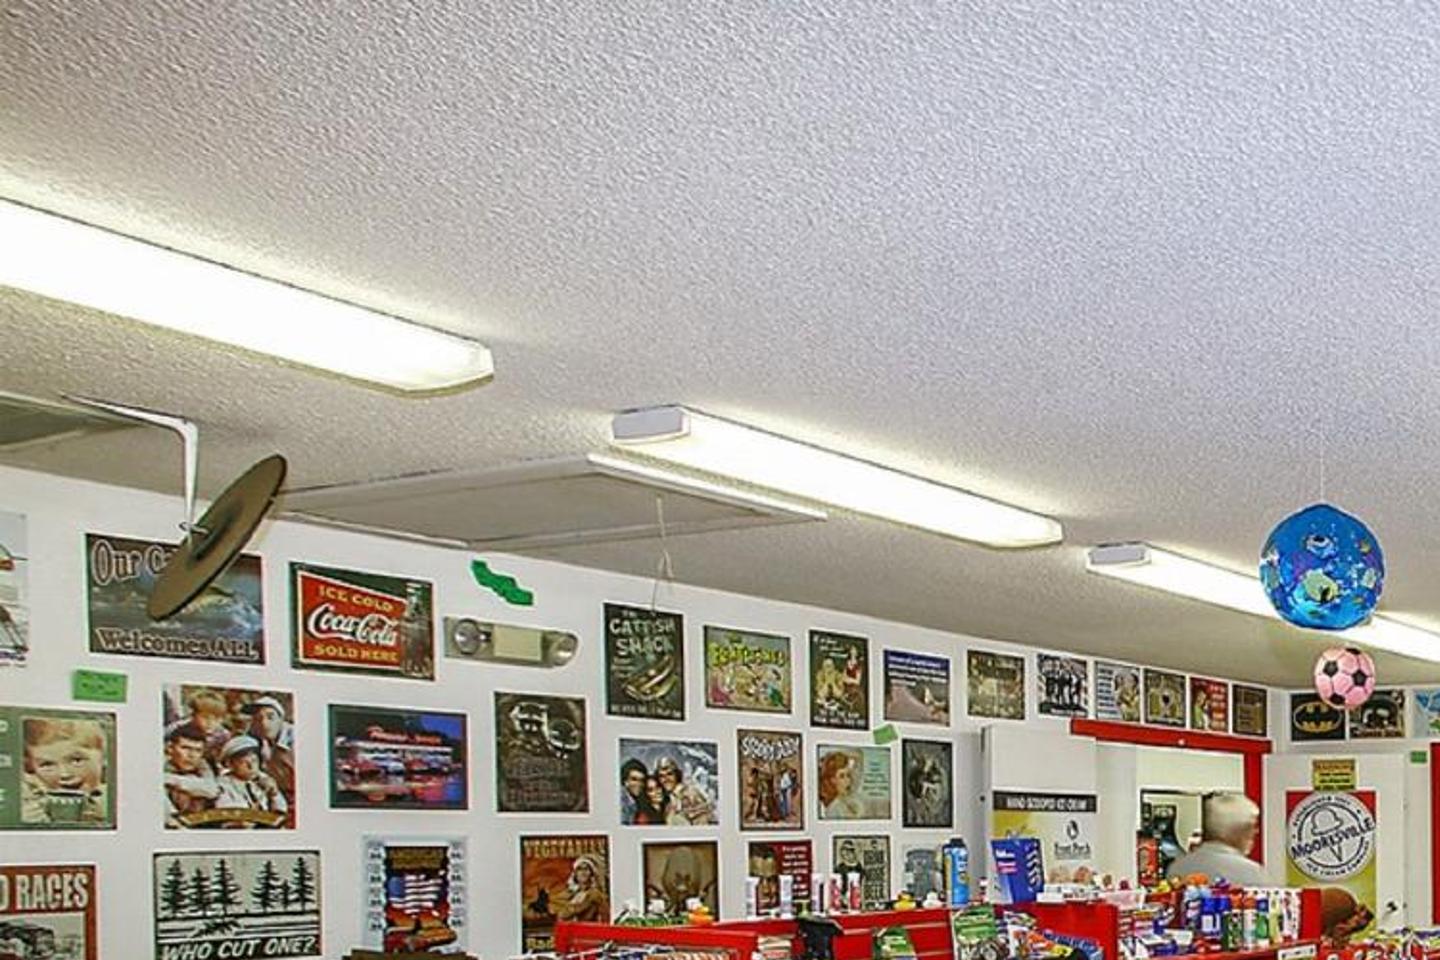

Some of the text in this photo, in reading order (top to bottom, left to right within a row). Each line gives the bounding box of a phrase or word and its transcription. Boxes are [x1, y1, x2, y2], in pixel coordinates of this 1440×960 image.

[93, 539, 142, 586] Our
[319, 584, 393, 612] ICE COLD
[308, 603, 398, 646] Coca-Cola
[95, 627, 208, 656] Welcomes
[314, 645, 399, 661] SOLD HERE
[1291, 817, 1375, 859] MOORESVILLE
[17, 873, 89, 911] RACES
[218, 939, 261, 958] CUT
[264, 935, 315, 956] ONE?
